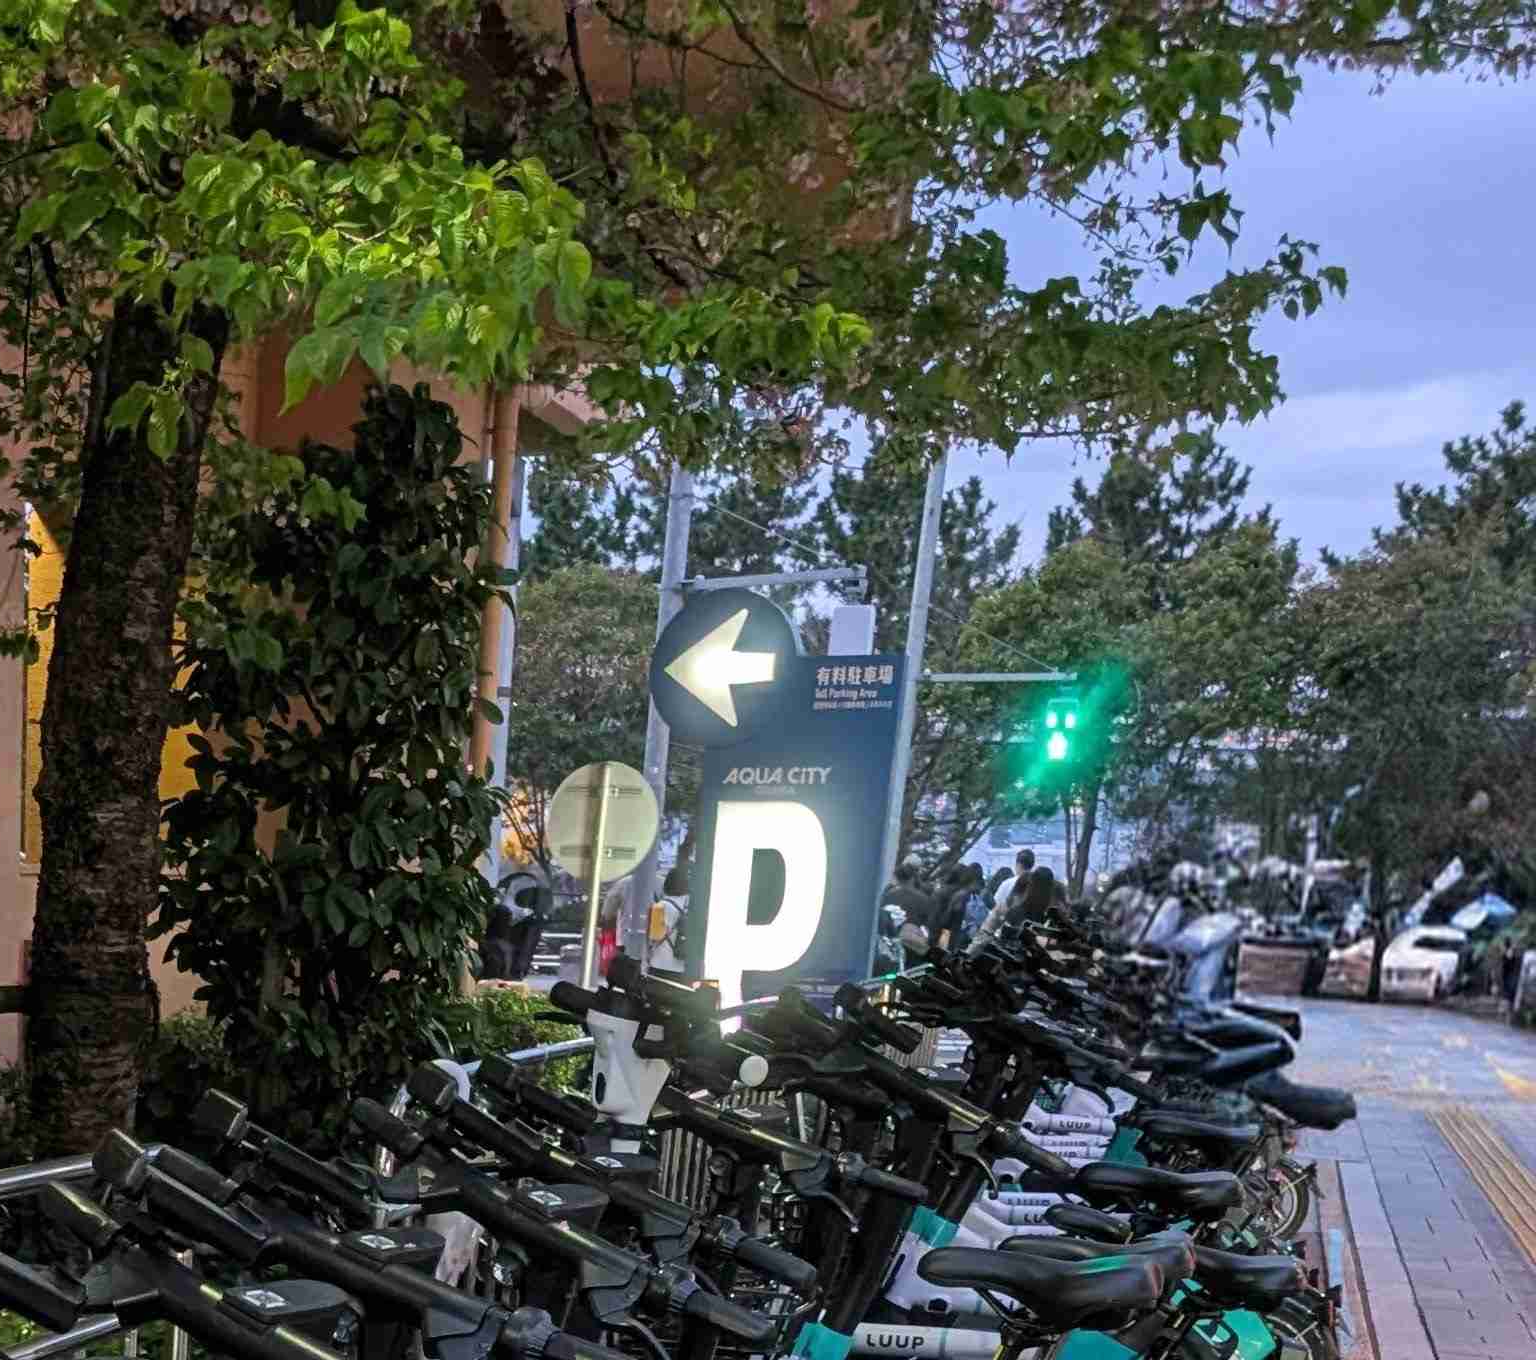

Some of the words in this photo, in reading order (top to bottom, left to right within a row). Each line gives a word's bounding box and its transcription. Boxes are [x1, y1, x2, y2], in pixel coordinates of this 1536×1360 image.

[816, 665, 894, 686] 有料駐車場
[723, 767, 783, 785] AQUA
[787, 766, 832, 785] CITY
[704, 801, 827, 1039] P
[866, 1333, 924, 1349] LUUP
